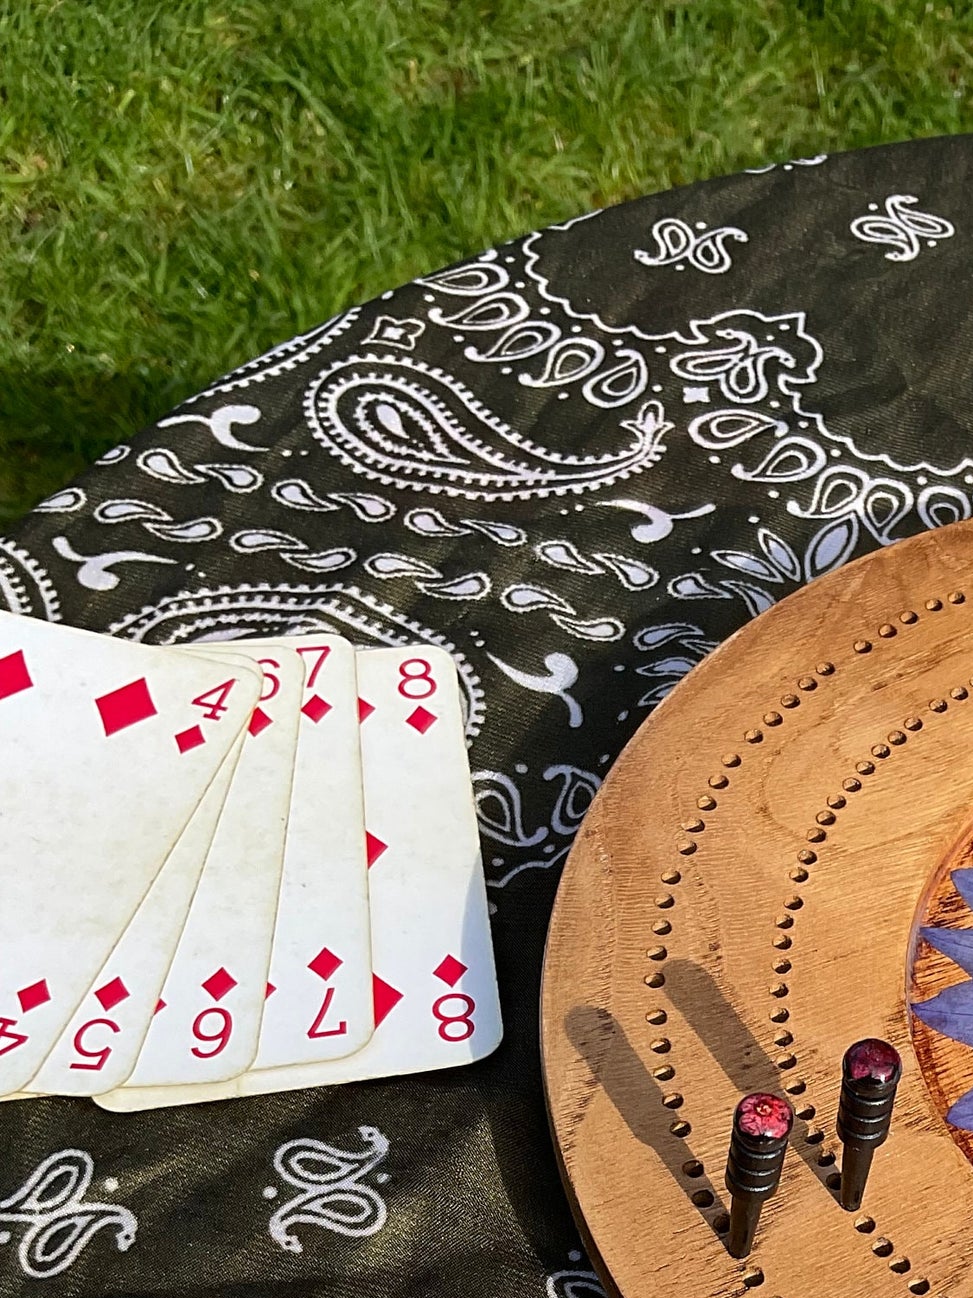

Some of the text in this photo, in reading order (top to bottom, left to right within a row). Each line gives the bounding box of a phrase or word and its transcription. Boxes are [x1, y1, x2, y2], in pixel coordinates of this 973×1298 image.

[296, 646, 331, 688] 7
[398, 658, 437, 699] 8
[191, 678, 237, 721] 4
[191, 1007, 232, 1059] 6
[307, 987, 347, 1040] 7
[432, 993, 475, 1042] 8
[69, 1018, 120, 1071] 5
